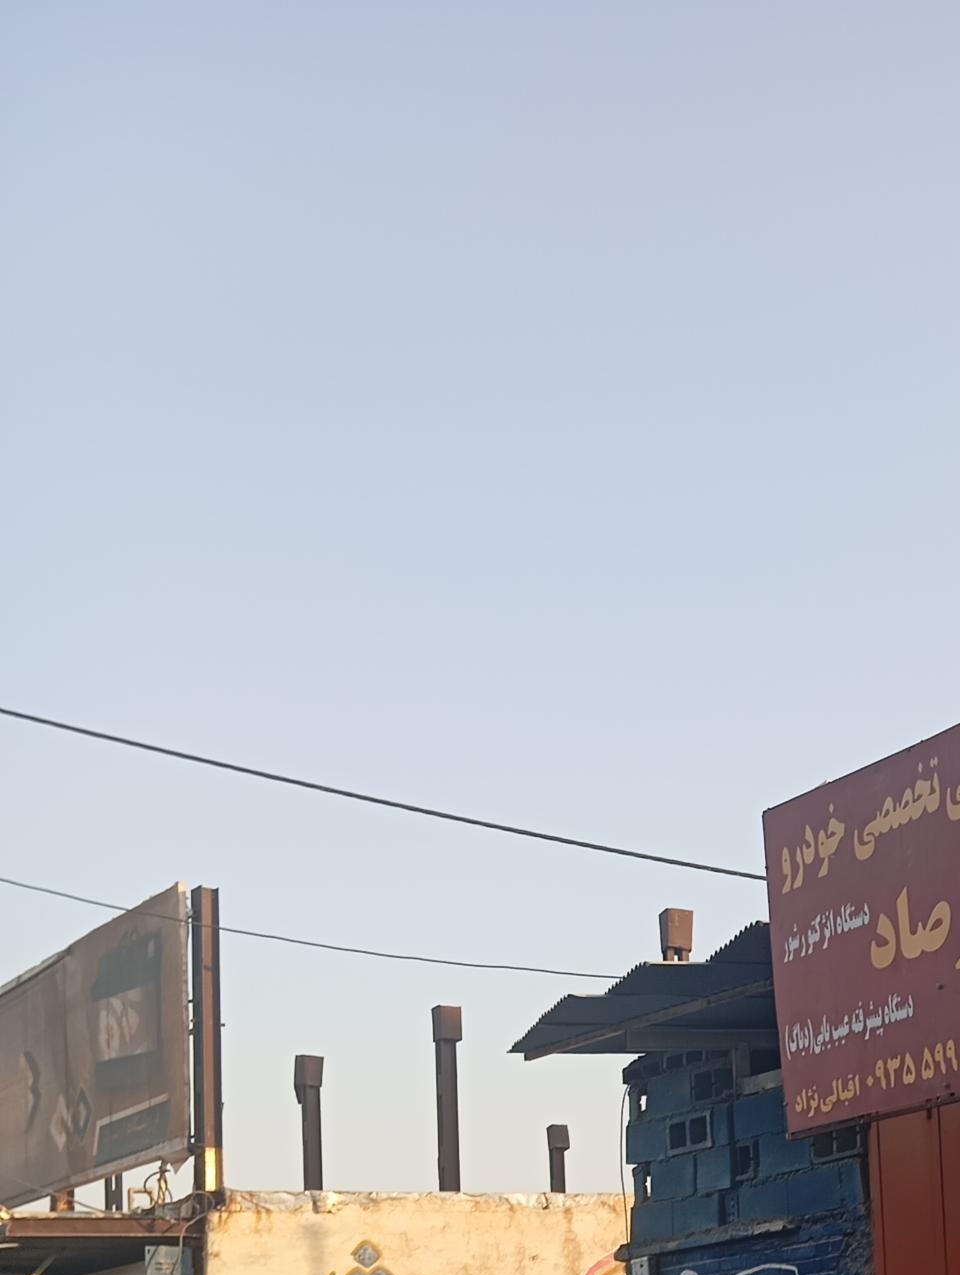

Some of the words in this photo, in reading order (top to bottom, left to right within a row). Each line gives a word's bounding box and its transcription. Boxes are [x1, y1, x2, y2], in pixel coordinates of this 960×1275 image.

[853, 756, 941, 861] تخصصی
[781, 803, 846, 895] خودرو
[836, 903, 870, 935] دستگاه
[852, 1001, 883, 1040] پیشرفته
[884, 992, 914, 1025] دستگاه
[866, 1053, 916, 1090] ۰۹۳۵
[921, 1040, 959, 1080] ۵۹۹
